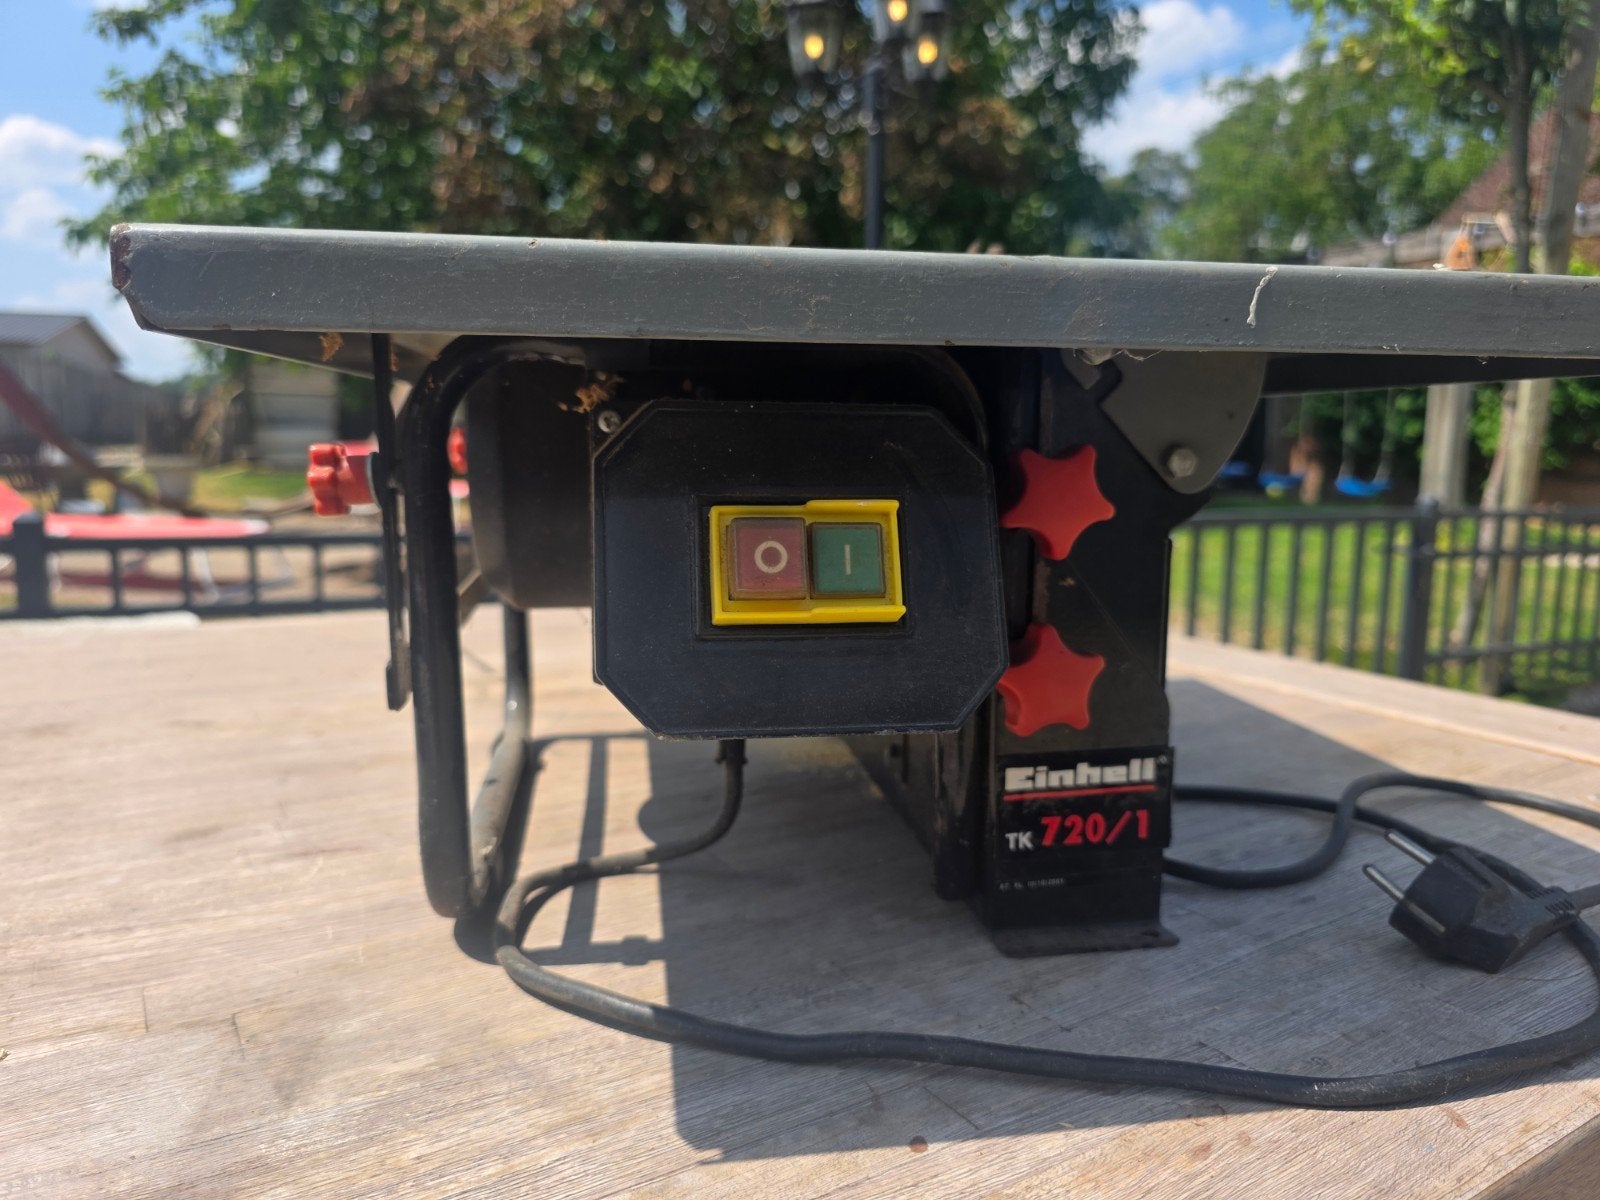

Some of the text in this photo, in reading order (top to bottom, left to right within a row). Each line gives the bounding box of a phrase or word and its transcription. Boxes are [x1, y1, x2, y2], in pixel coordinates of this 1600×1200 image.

[1005, 757, 1156, 791] Einhell
[1005, 809, 1149, 850] TK 720/1
